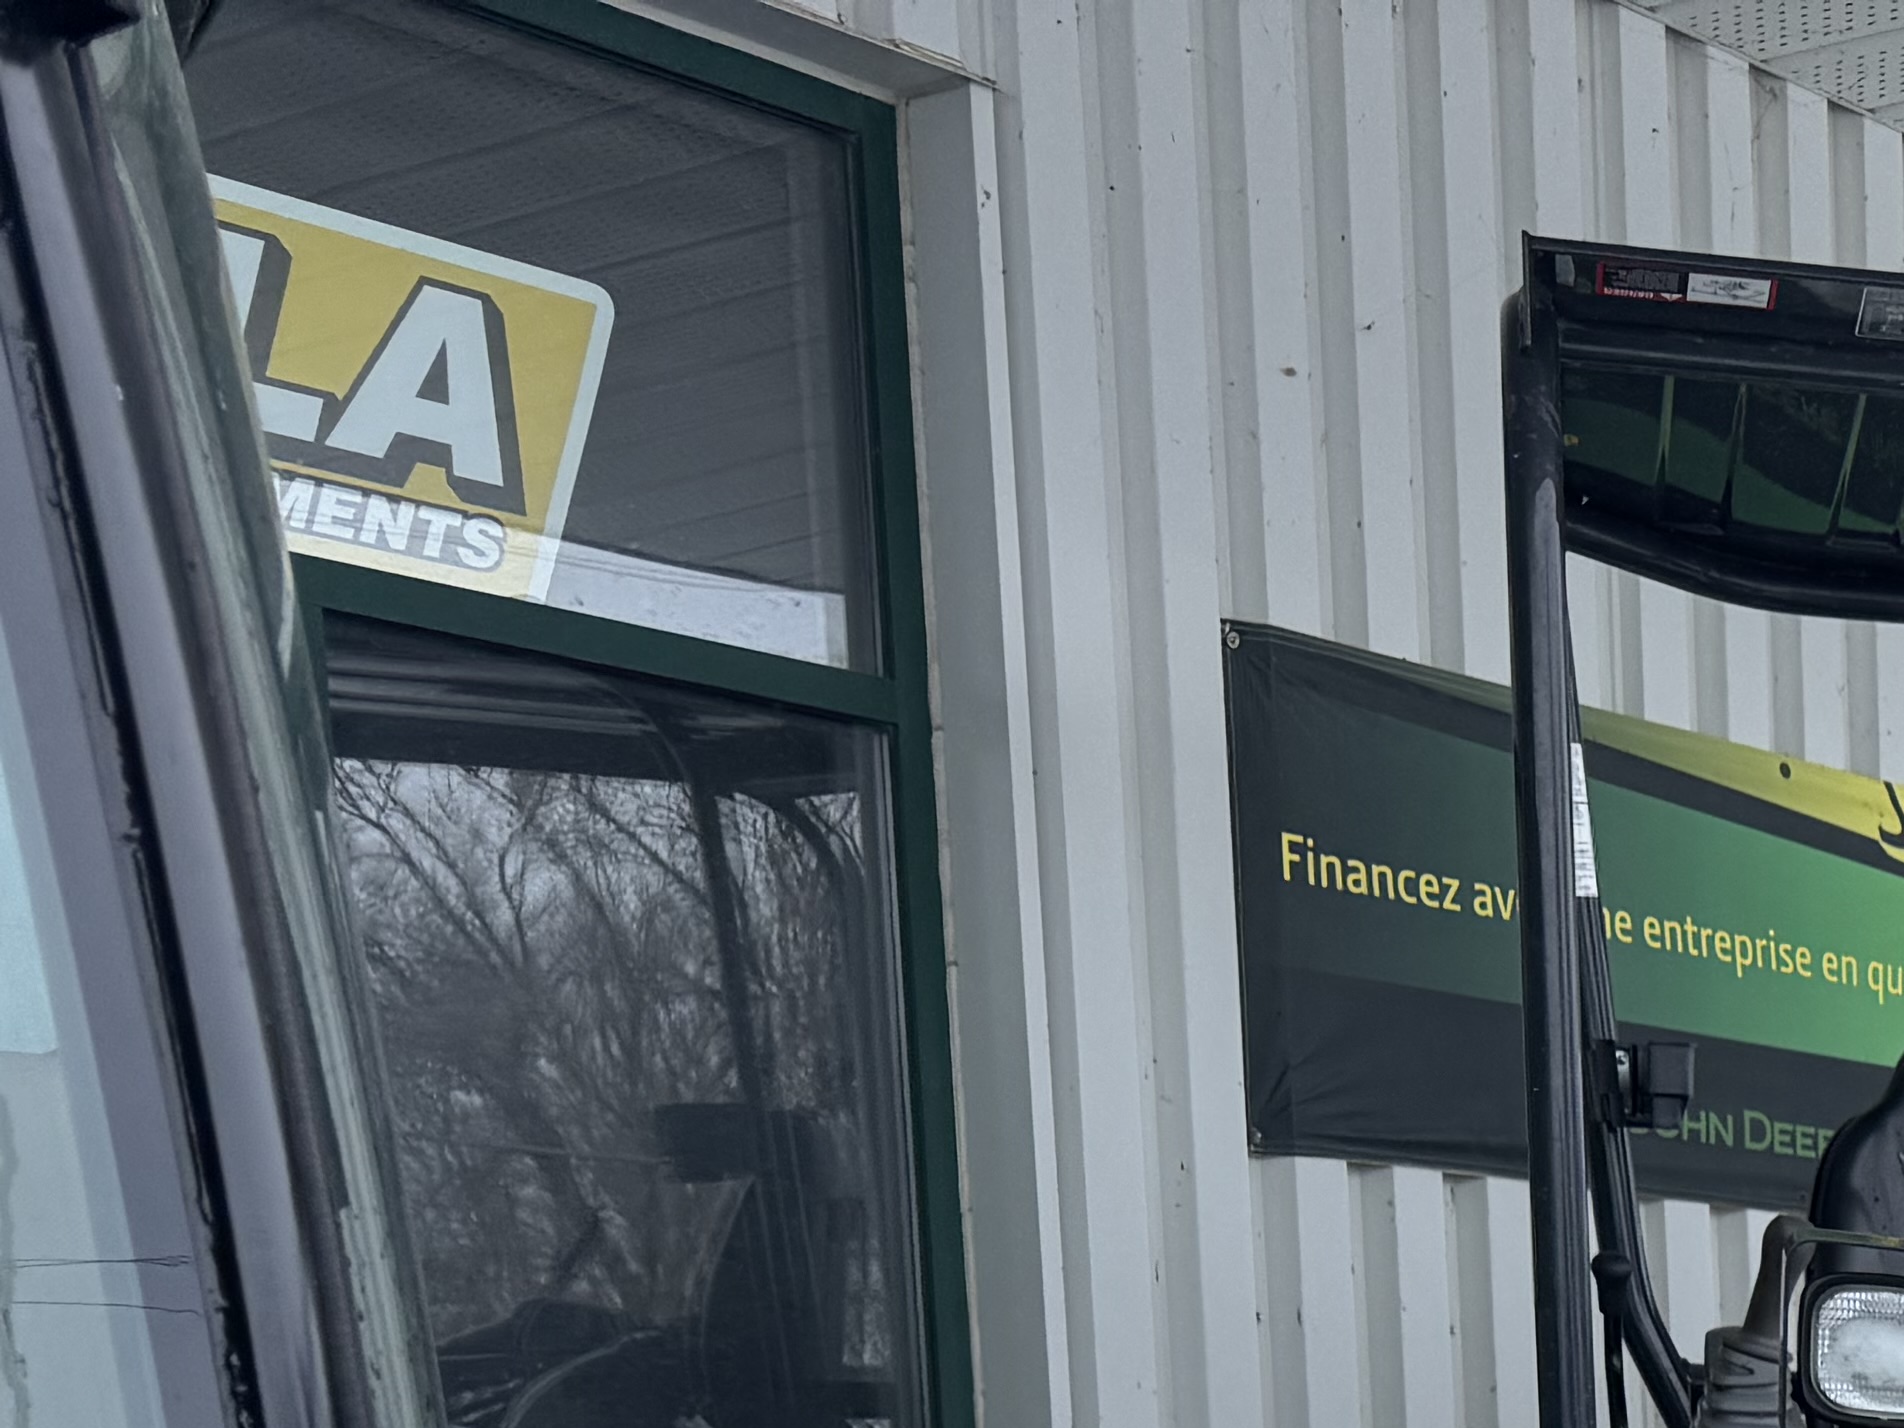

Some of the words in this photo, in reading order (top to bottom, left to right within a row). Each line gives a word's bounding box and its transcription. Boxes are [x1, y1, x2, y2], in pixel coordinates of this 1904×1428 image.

[218, 222, 527, 517] LA
[272, 472, 505, 569] MENTS
[1281, 831, 1461, 912] Financez
[1473, 882, 1516, 921] av
[1643, 916, 1812, 978] entreprise
[1822, 951, 1857, 987] en
